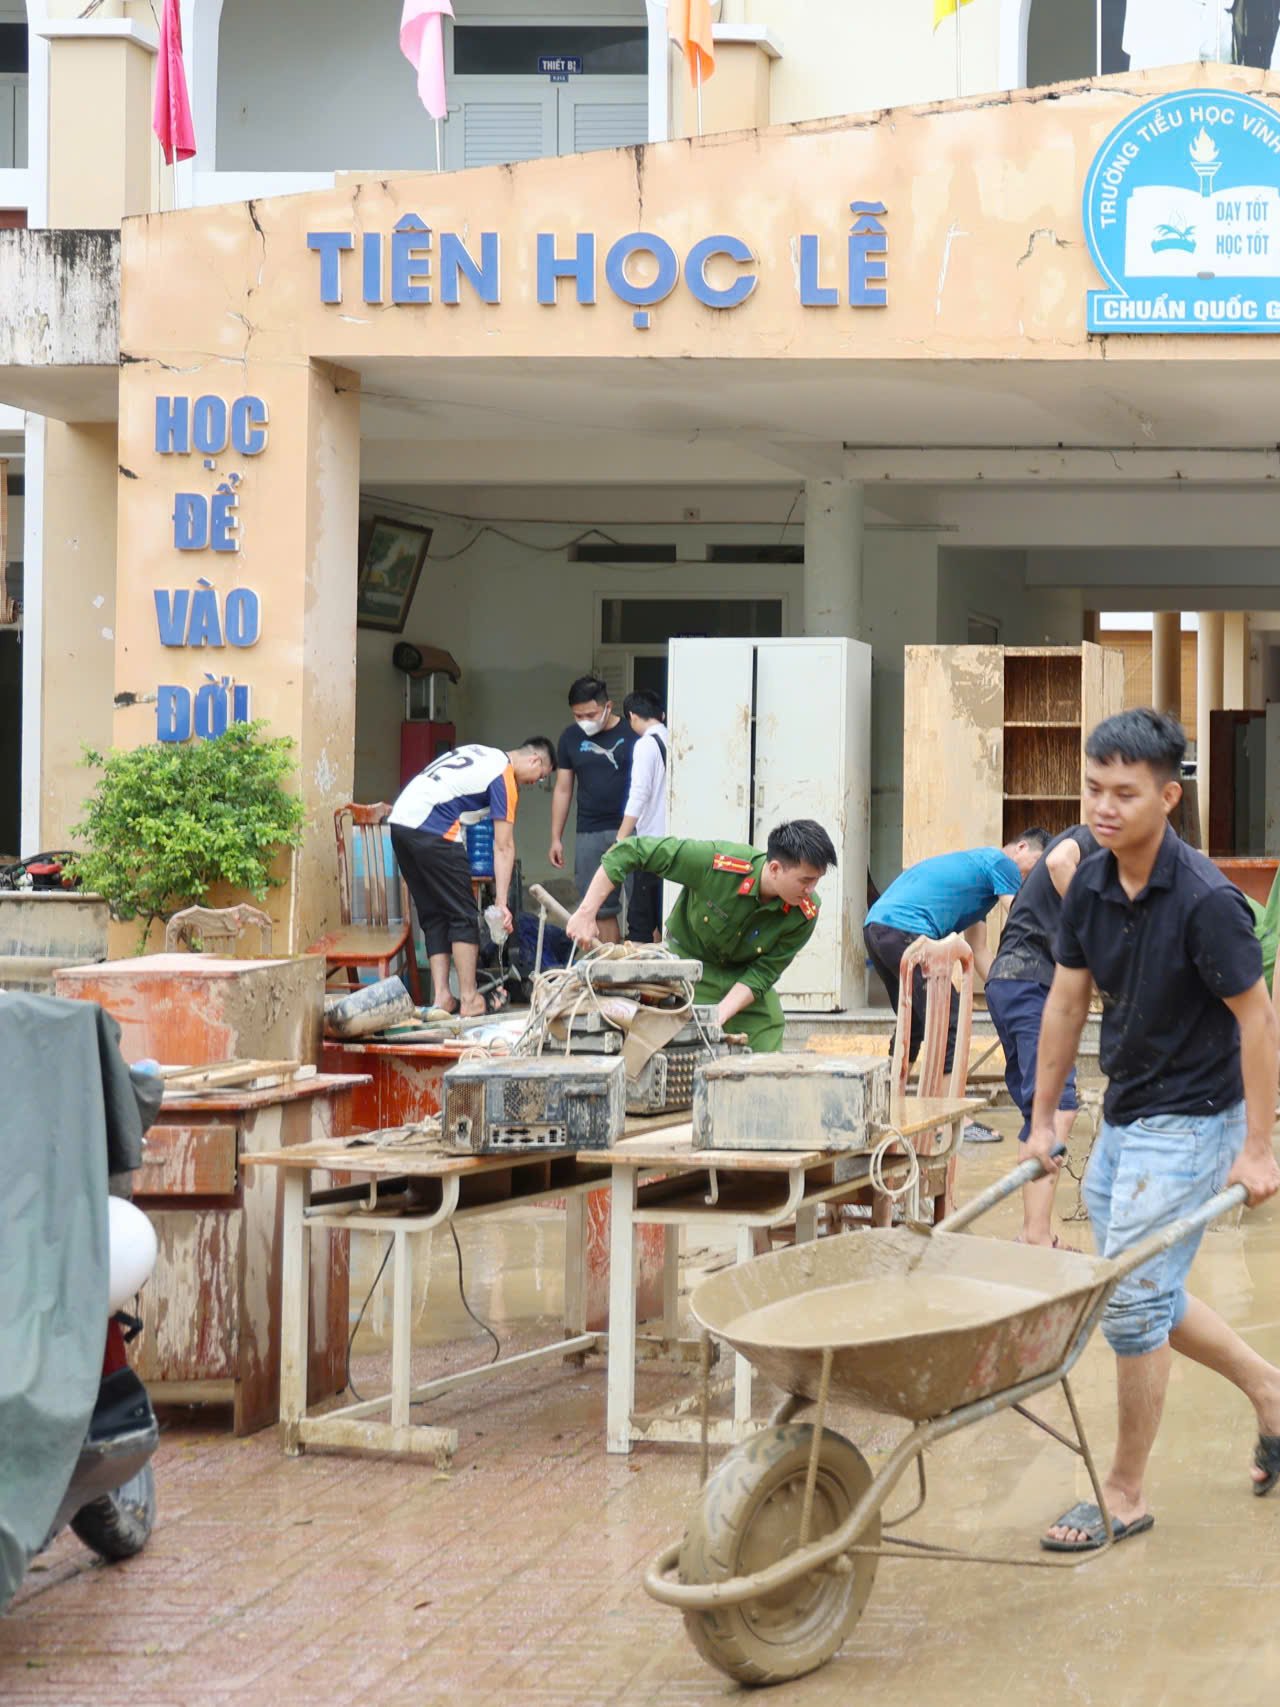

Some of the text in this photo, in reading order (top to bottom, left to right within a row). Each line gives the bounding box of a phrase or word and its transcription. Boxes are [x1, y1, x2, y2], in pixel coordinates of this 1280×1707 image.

[542, 57, 576, 73] THIẾT BỊ
[1100, 141, 1140, 229] TRƯỜNG
[1137, 108, 1184, 143] TIỂU
[1190, 106, 1235, 126] HỌC
[1216, 194, 1269, 226] DẠY TỐT
[1216, 228, 1270, 260] HỌC TỐT
[307, 200, 888, 329] TIÊN HỌC LỄ
[1103, 293, 1186, 320] CHUẨN
[1193, 294, 1258, 321] QUỐC
[154, 394, 270, 470] HỌC
[172, 472, 241, 552] ĐỂ
[153, 576, 262, 649] VÀO
[155, 671, 251, 743] ĐỜI
